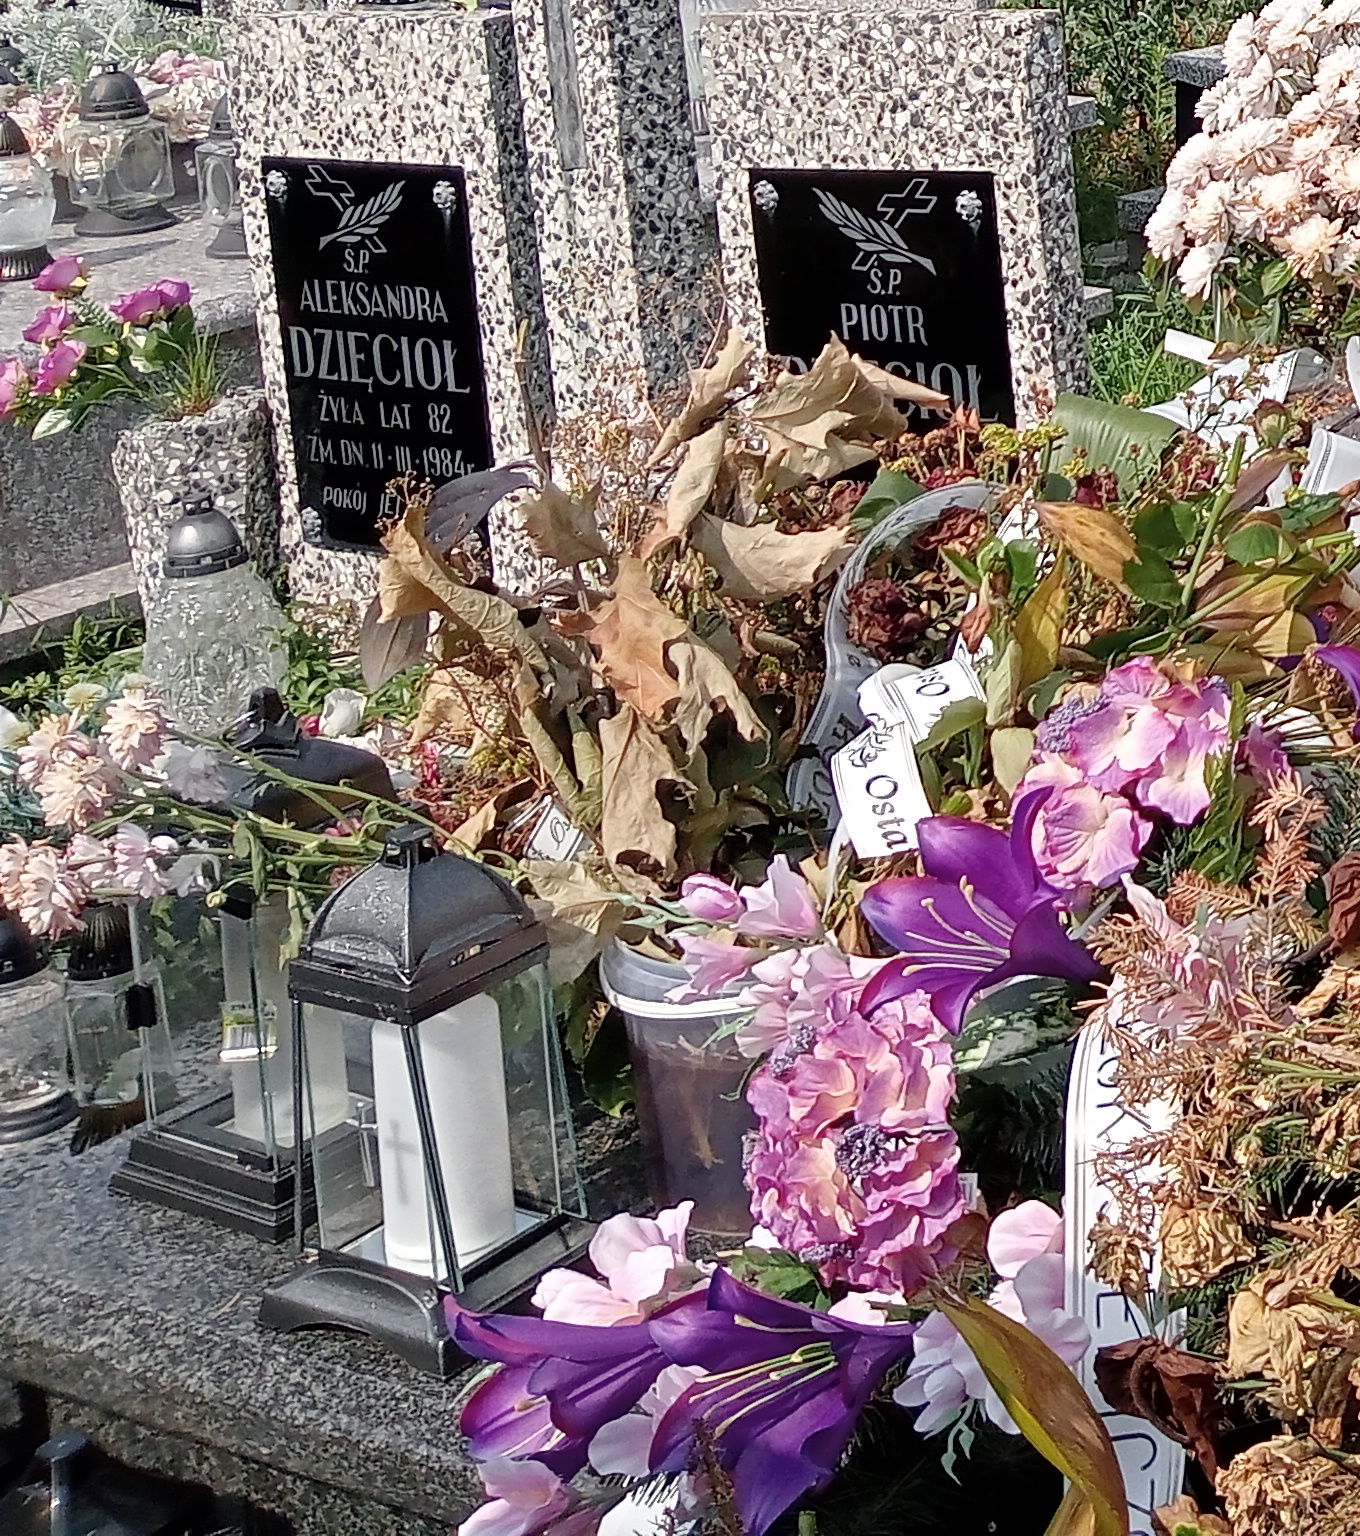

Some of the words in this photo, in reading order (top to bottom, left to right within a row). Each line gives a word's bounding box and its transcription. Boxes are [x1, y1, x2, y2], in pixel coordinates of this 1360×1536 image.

[300, 278, 449, 324] ALEKSANDRA
[840, 303, 928, 346] PIOTR
[289, 325, 470, 394] DZIĘCIOŁ
[318, 388, 365, 426] ŻYŁA
[380, 401, 411, 430] LAT
[427, 403, 453, 435] 82
[307, 435, 338, 465] ZM.
[340, 439, 370, 468] DN.
[322, 482, 367, 515] POKÓJ
